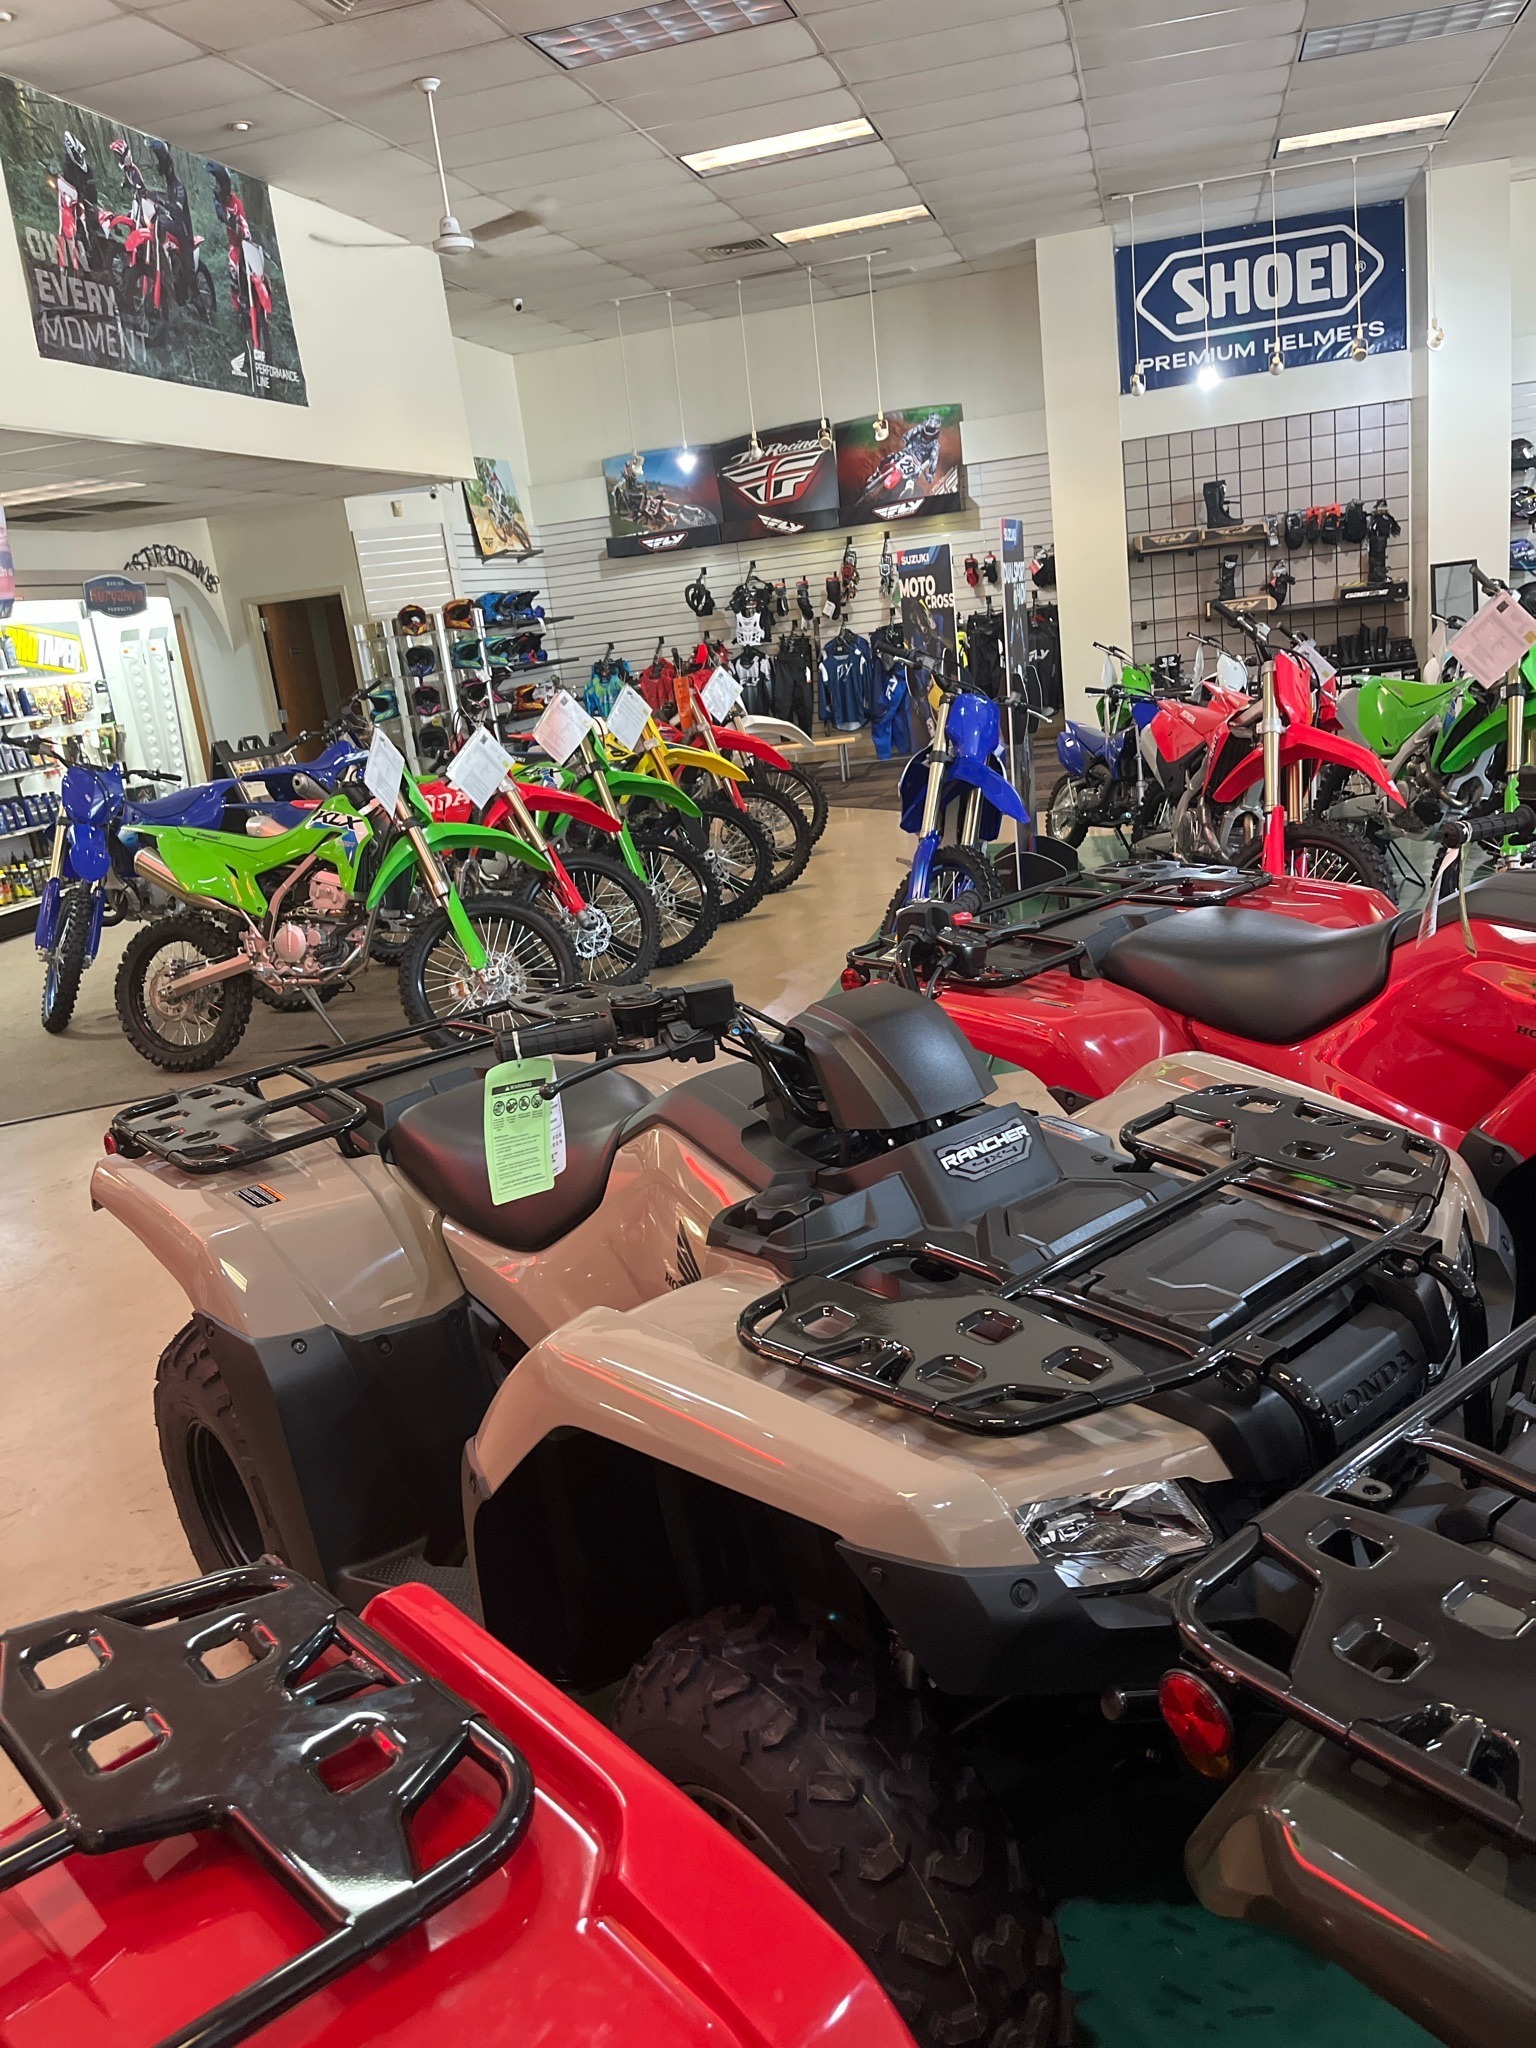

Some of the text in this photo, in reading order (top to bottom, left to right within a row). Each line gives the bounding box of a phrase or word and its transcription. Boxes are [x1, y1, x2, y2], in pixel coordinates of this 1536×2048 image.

[25, 226, 91, 272] OWN
[34, 268, 115, 317] EVERY
[1172, 242, 1348, 325] SHOEI
[41, 311, 149, 362] MOMENT
[1139, 320, 1386, 372] PREMIUM HELMETS
[254, 362, 300, 382] PERFORMANCE
[256, 375, 271, 389] LINE
[900, 458, 916, 476] 29
[873, 498, 924, 518] FLY
[757, 514, 805, 533] FLY
[641, 533, 686, 547] FLY
[901, 552, 930, 566] SUZUKI
[898, 574, 936, 599] MOTO
[925, 592, 955, 609] CROSS
[1028, 649, 1050, 662] FLY
[837, 662, 853, 681] FLY
[311, 810, 364, 831] KLX
[940, 1124, 1031, 1171] RANCHER
